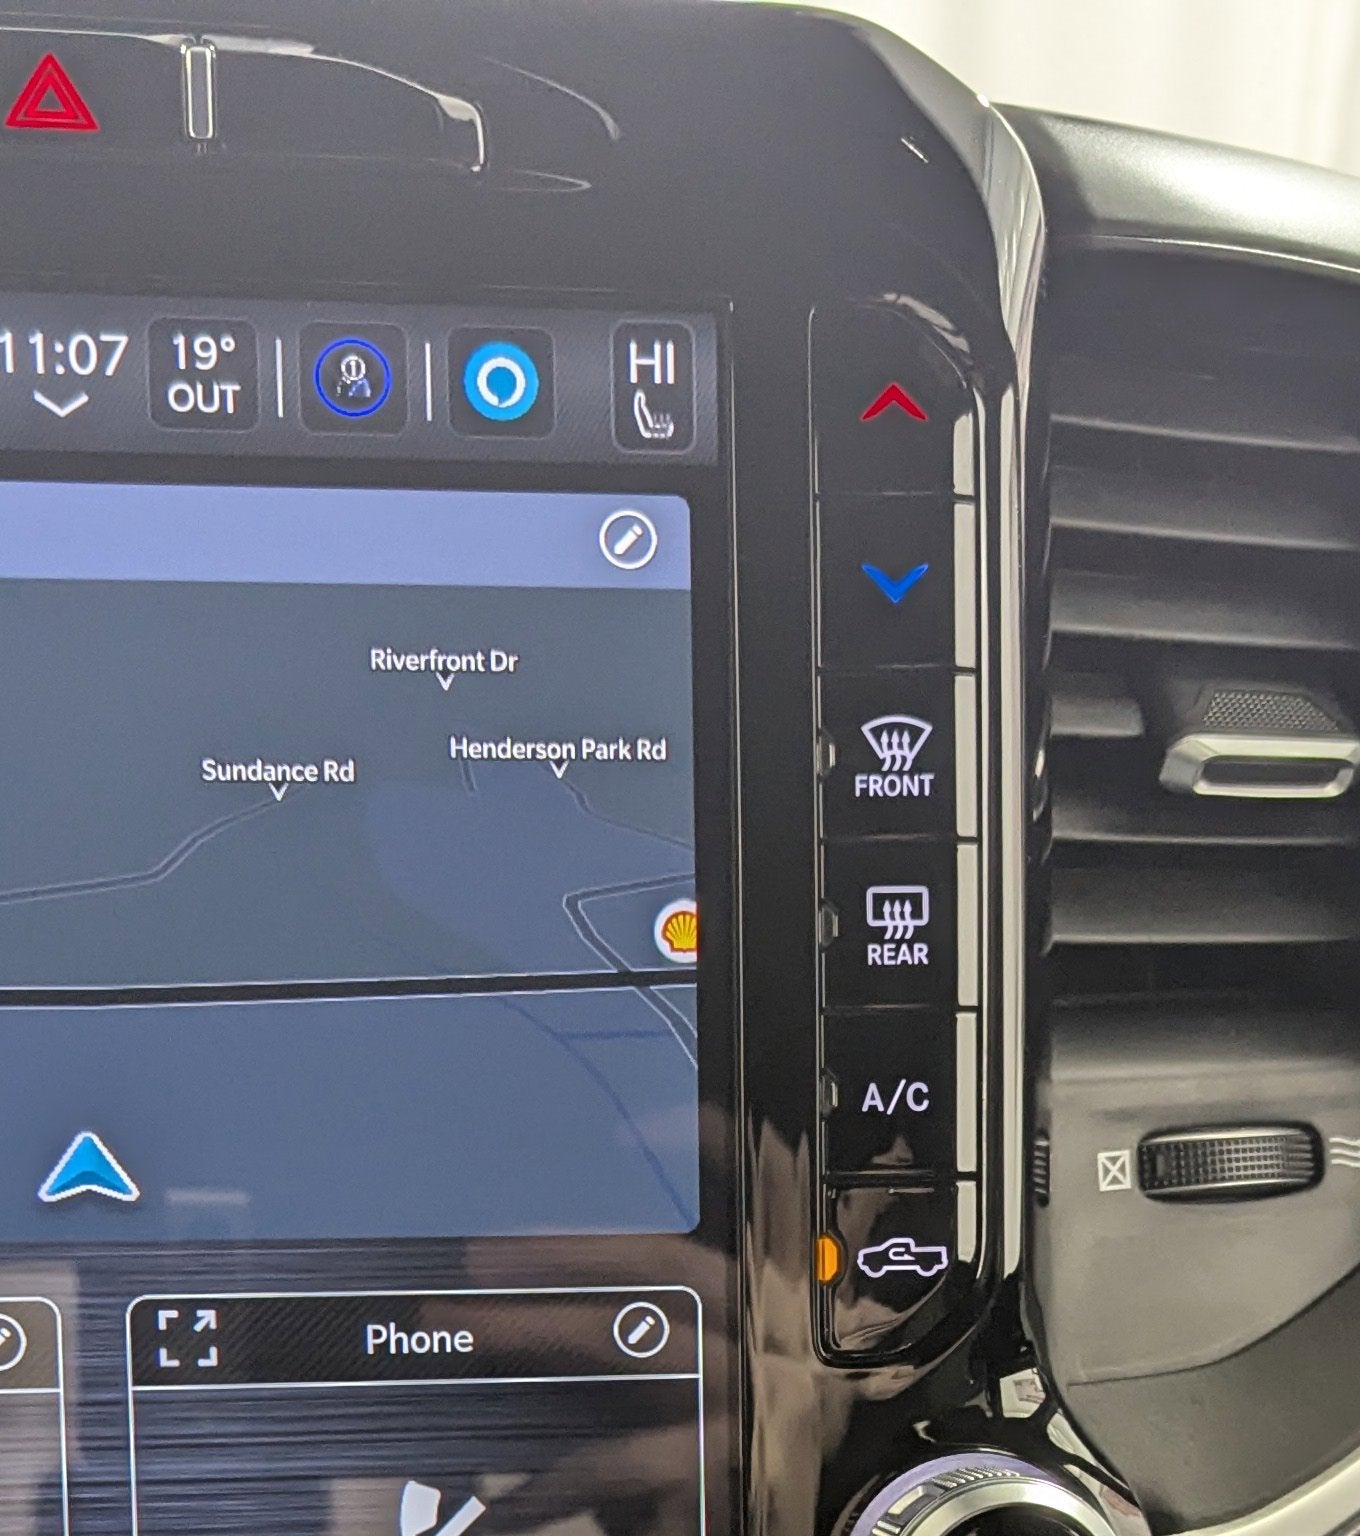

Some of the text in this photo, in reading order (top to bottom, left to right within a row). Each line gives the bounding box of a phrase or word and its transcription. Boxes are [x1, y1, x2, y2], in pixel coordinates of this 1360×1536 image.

[629, 340, 675, 385] HI
[167, 381, 241, 414] OUT
[370, 647, 519, 672] Riverfront Dr
[450, 736, 667, 761] Henderson Park Rd
[202, 758, 355, 783] Sundance Rd
[855, 773, 935, 797] FRONT
[867, 942, 929, 966] REAR
[861, 1078, 930, 1115] A/C
[366, 1321, 474, 1355] Phone
